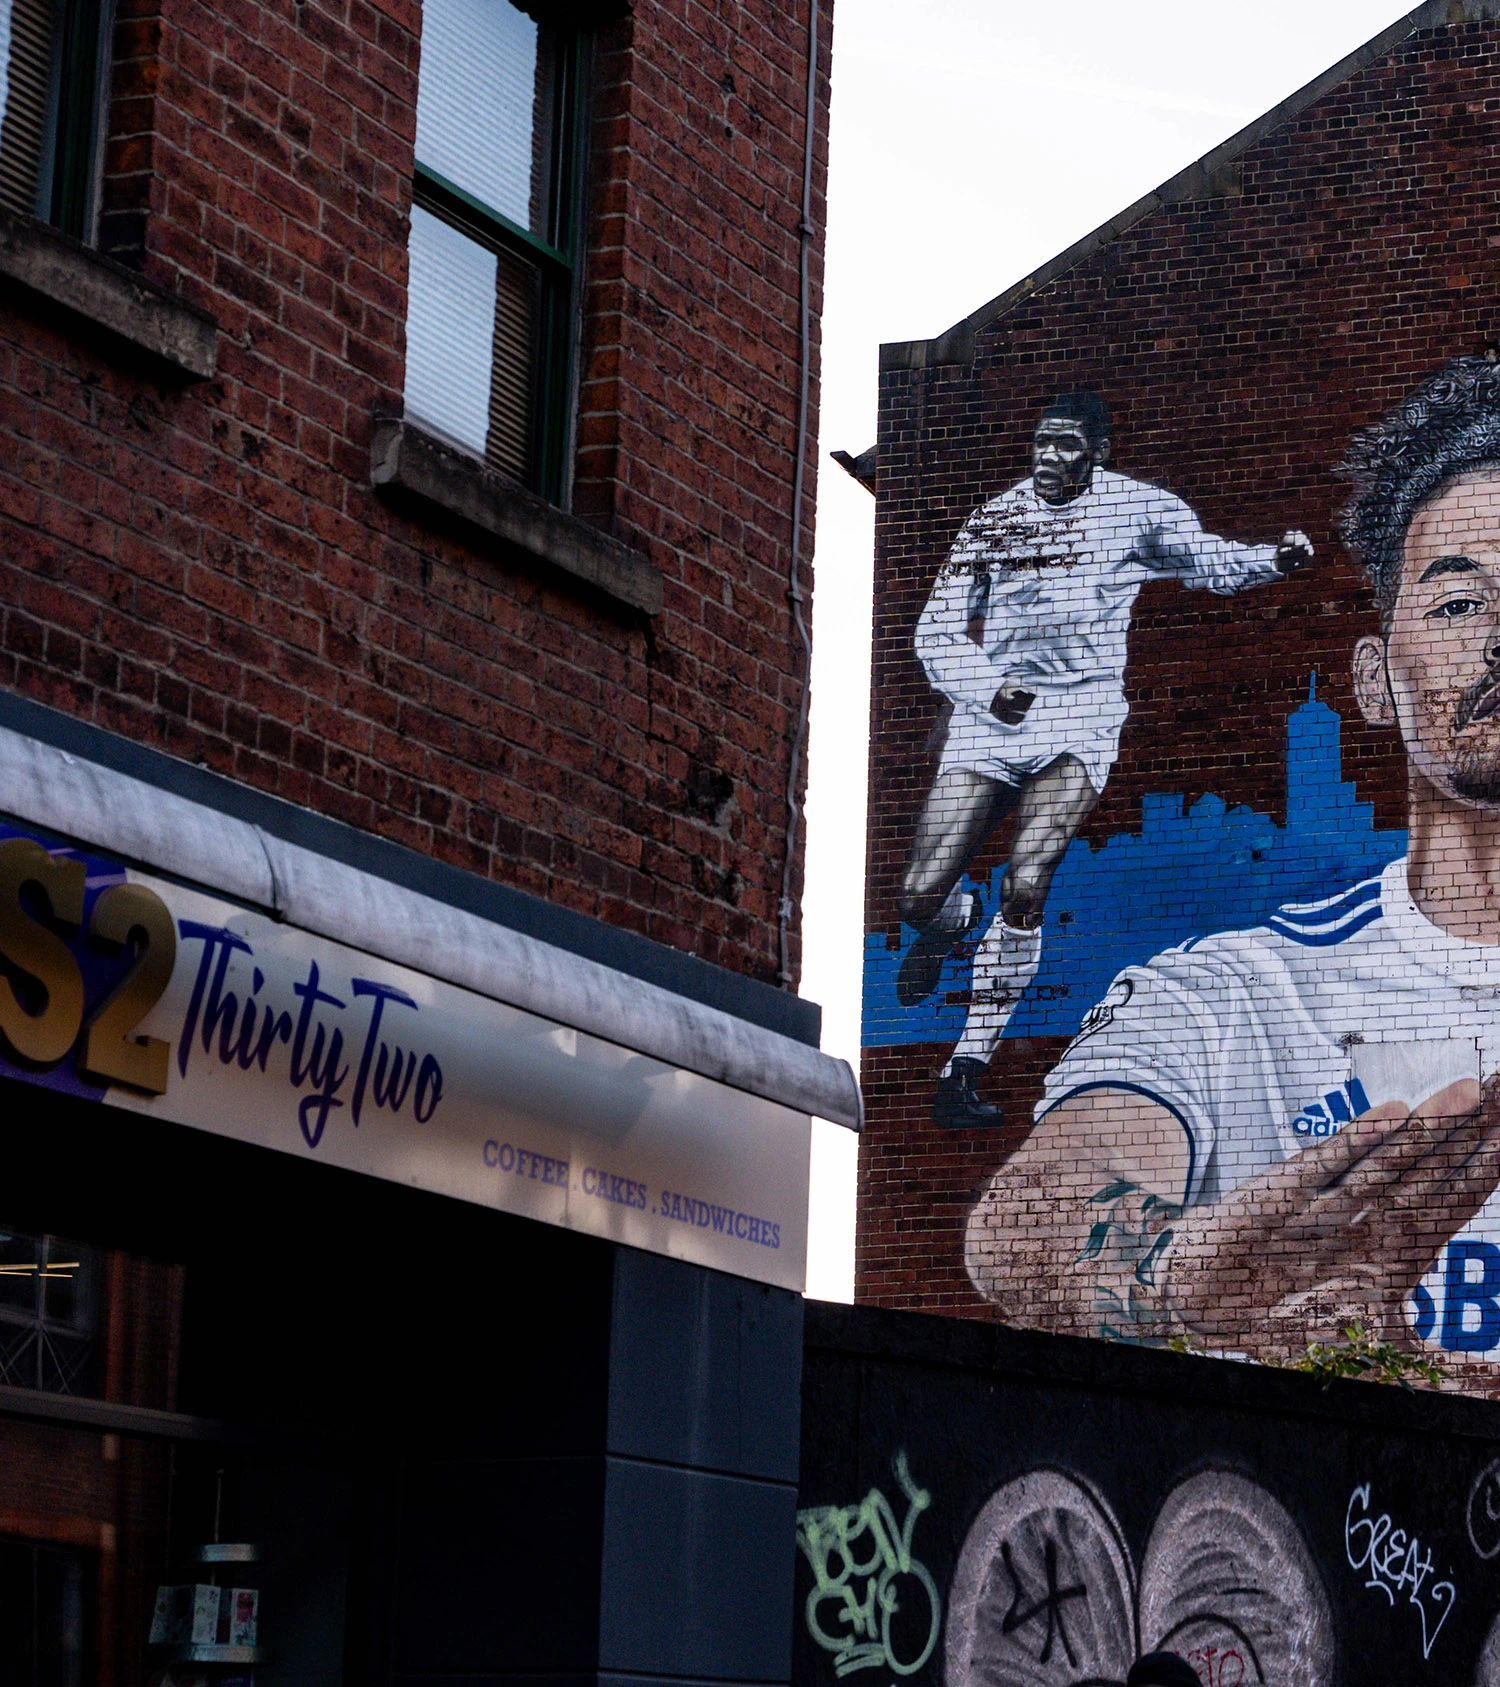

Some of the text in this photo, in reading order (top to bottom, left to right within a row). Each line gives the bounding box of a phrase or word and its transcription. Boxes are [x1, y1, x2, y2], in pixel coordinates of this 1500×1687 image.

[177, 918, 350, 1149] Thirty
[351, 977, 443, 1129] Two
[482, 1138, 781, 1250] COFFEE CAKES SANDWICHES
